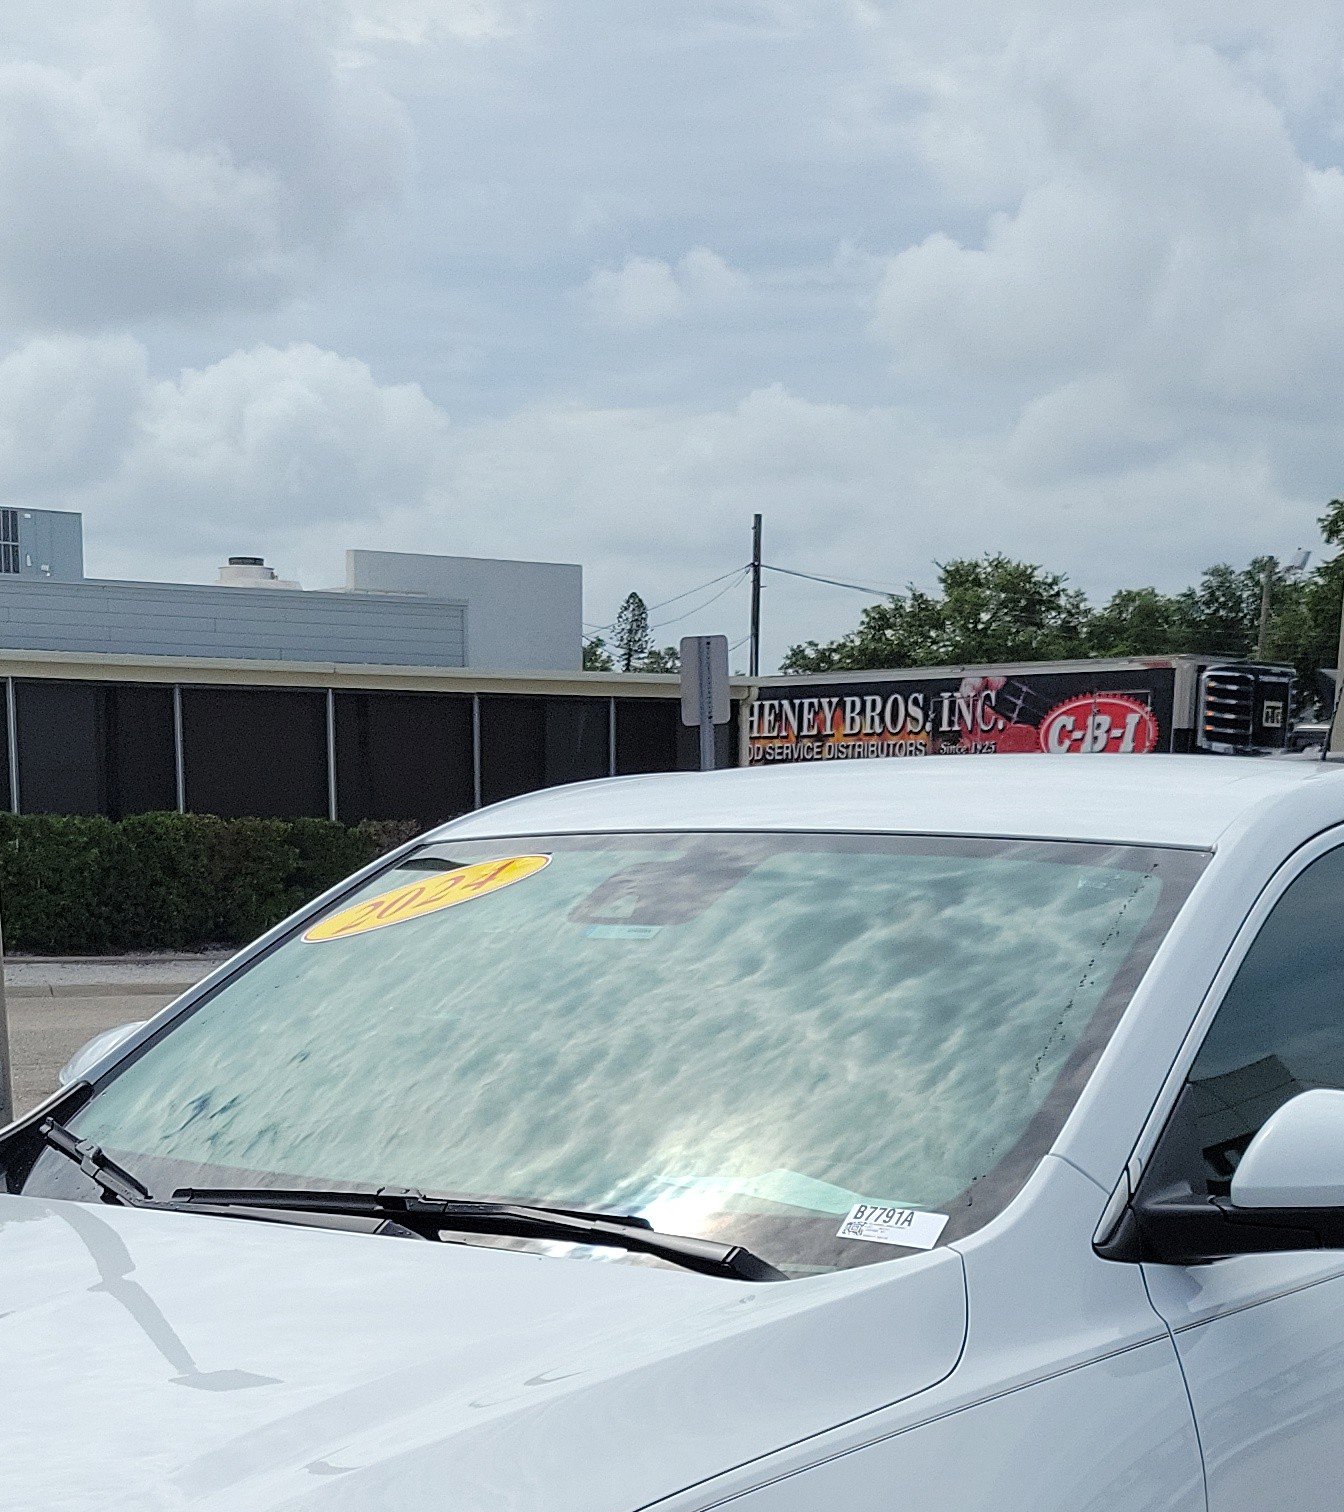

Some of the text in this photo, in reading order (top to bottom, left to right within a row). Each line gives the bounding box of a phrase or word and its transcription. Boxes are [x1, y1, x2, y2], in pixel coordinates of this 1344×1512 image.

[843, 693, 932, 735] BROS.
[939, 691, 1004, 732] INC.
[940, 742, 968, 754] Since
[1048, 713, 1141, 753] C-B-I
[765, 742, 823, 760] SERVICE
[826, 740, 927, 759] DISTRIBUTORS
[332, 860, 516, 935] 2024
[853, 1204, 915, 1227] B7791A
